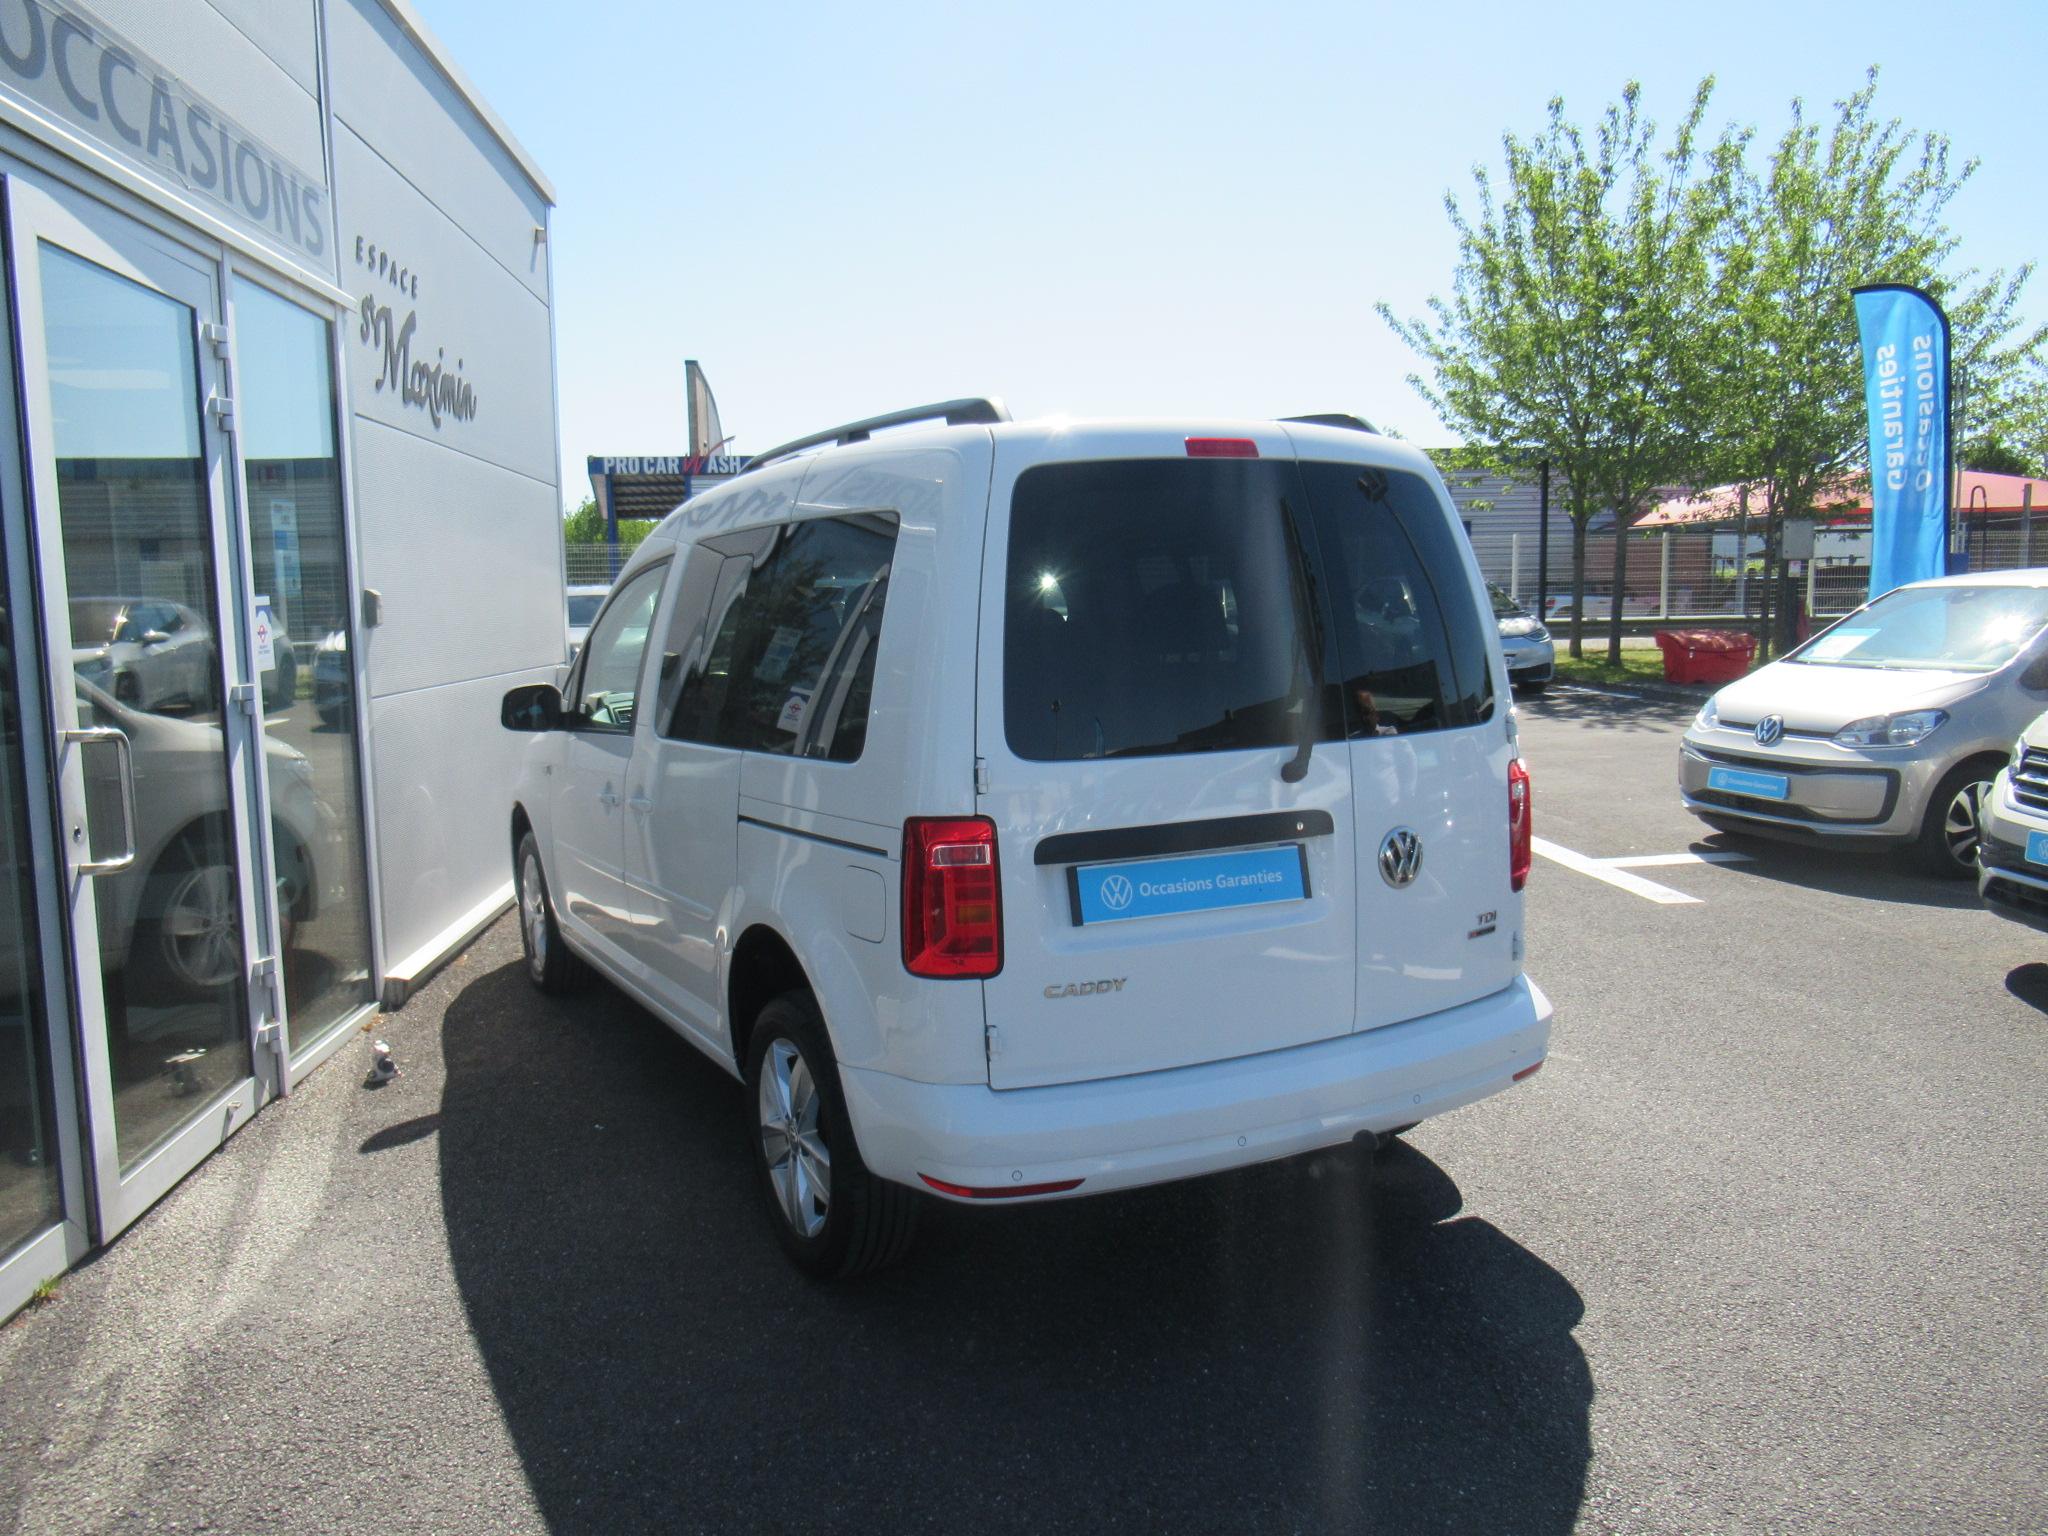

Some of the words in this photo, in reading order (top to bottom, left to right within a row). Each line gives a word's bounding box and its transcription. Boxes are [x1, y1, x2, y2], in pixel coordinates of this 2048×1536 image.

[0, 0, 324, 257] OCCASIONS
[355, 235, 418, 299] ESPACE
[374, 305, 477, 428] Maximin
[603, 456, 640, 475] PRO
[642, 456, 680, 475] CAR
[1139, 878, 1212, 897] Occasions
[1215, 870, 1283, 889] Garanties
[1043, 976, 1128, 999] CADDY
